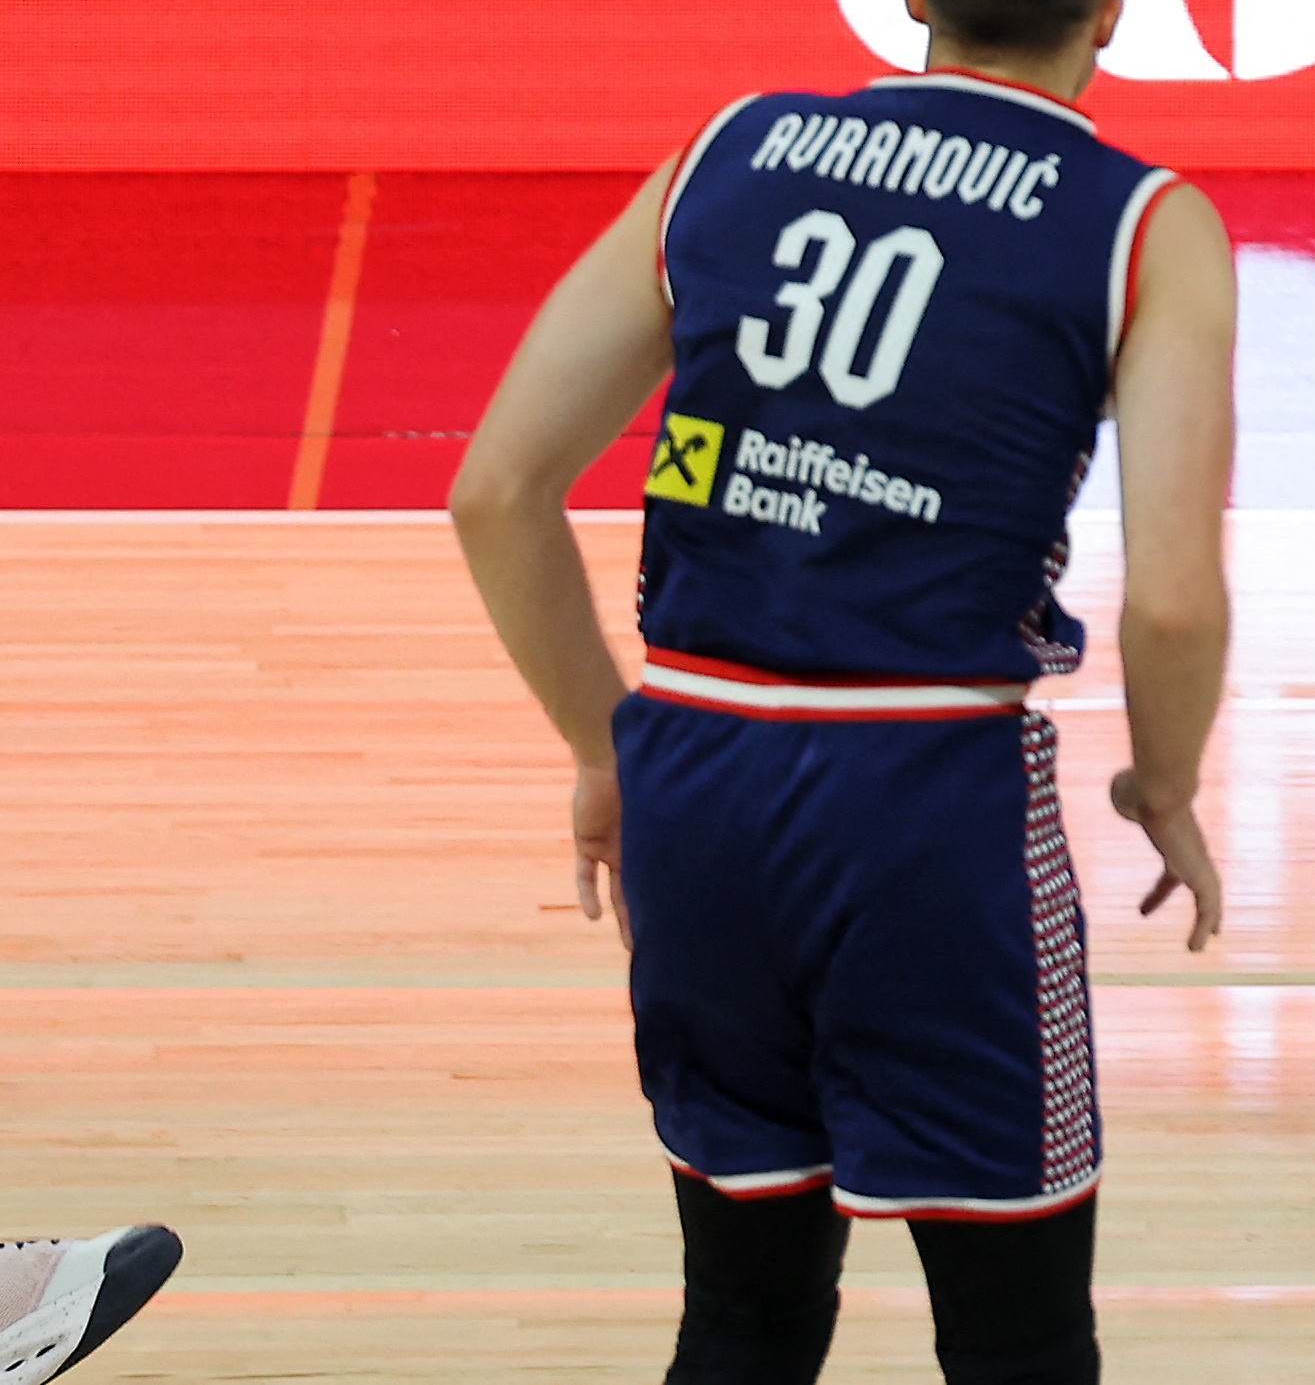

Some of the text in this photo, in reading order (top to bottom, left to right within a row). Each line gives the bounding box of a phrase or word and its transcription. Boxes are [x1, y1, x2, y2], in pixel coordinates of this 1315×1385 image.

[751, 112, 1061, 220] AVRAMOVIĆ
[735, 209, 945, 410] 30
[722, 471, 828, 536] Bank
[734, 427, 942, 523] Raiffeisen
